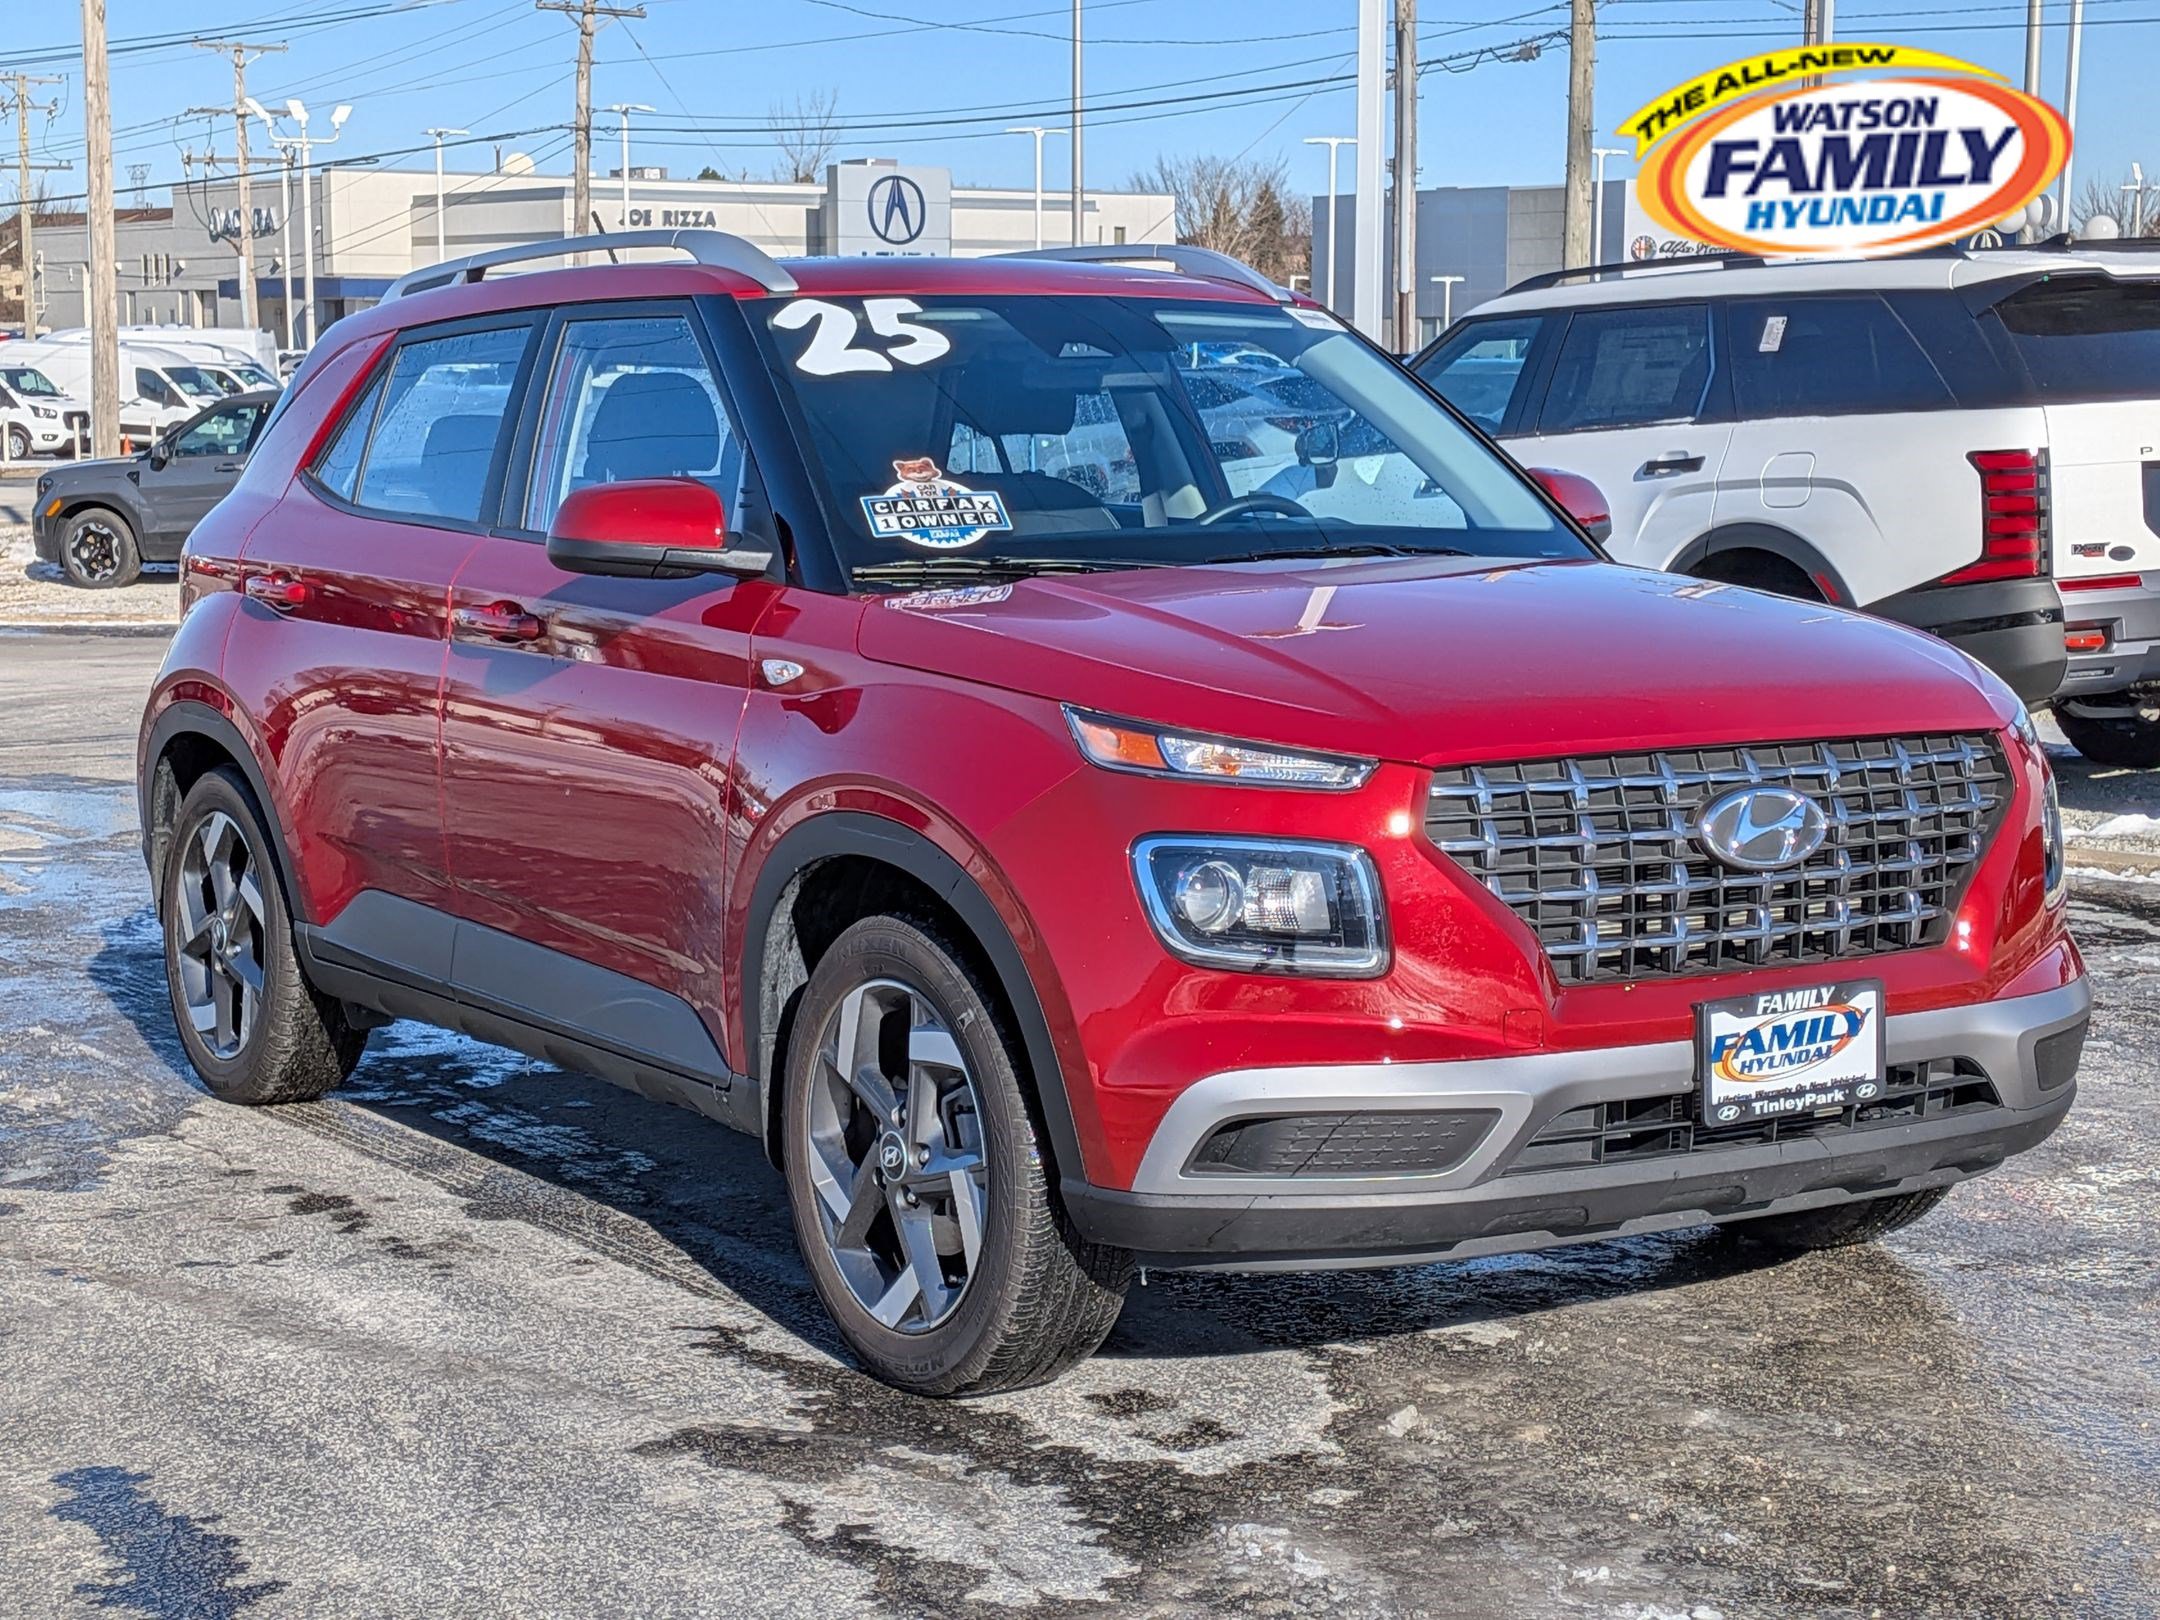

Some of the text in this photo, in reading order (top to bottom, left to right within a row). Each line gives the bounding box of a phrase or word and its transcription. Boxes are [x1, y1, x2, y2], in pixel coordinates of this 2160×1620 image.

[661, 209, 717, 228] RIZZA
[772, 298, 951, 376] 25
[873, 497, 995, 514] CARFAX
[1756, 985, 1836, 1015] FAMILY
[1712, 1007, 1873, 1063] FAMILY
[1738, 1044, 1834, 1074] HYUNDAI
